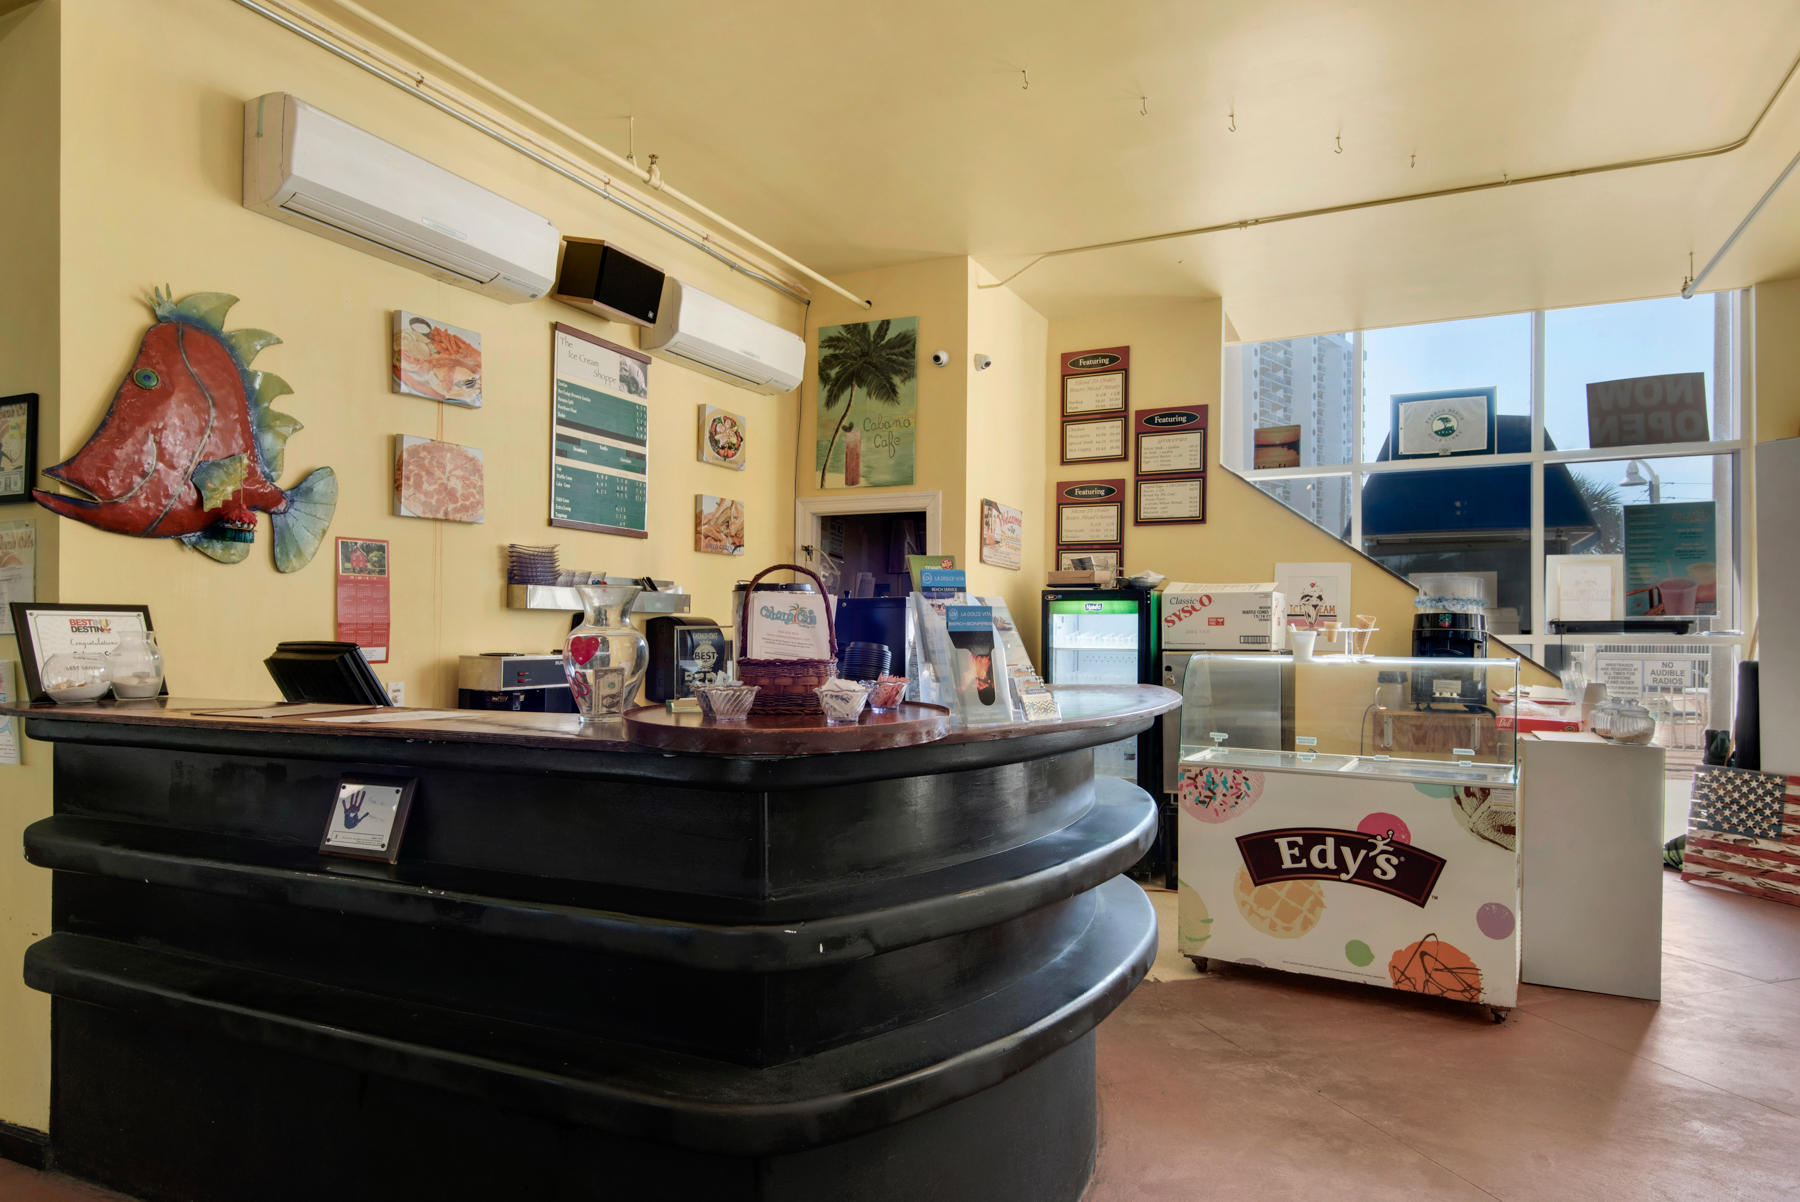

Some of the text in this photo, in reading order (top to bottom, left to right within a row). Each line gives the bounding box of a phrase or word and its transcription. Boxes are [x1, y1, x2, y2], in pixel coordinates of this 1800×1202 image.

[560, 336, 574, 348] The
[568, 350, 600, 367] Ice Cream
[1079, 356, 1110, 367] Featuring
[593, 368, 617, 385] Shoppe
[1154, 415, 1187, 424] Featuring
[873, 431, 901, 459] Cafe
[1074, 487, 1106, 496] Featuring
[1169, 595, 1198, 606] Classic
[1163, 594, 1213, 629] SYSCO
[69, 618, 92, 626] BEST
[694, 651, 717, 660] BEST
[1661, 661, 1674, 669] NO
[1650, 669, 1686, 677] AUDIBLE
[1652, 677, 1684, 685] RADIOS
[1274, 834, 1400, 881] Edy's
